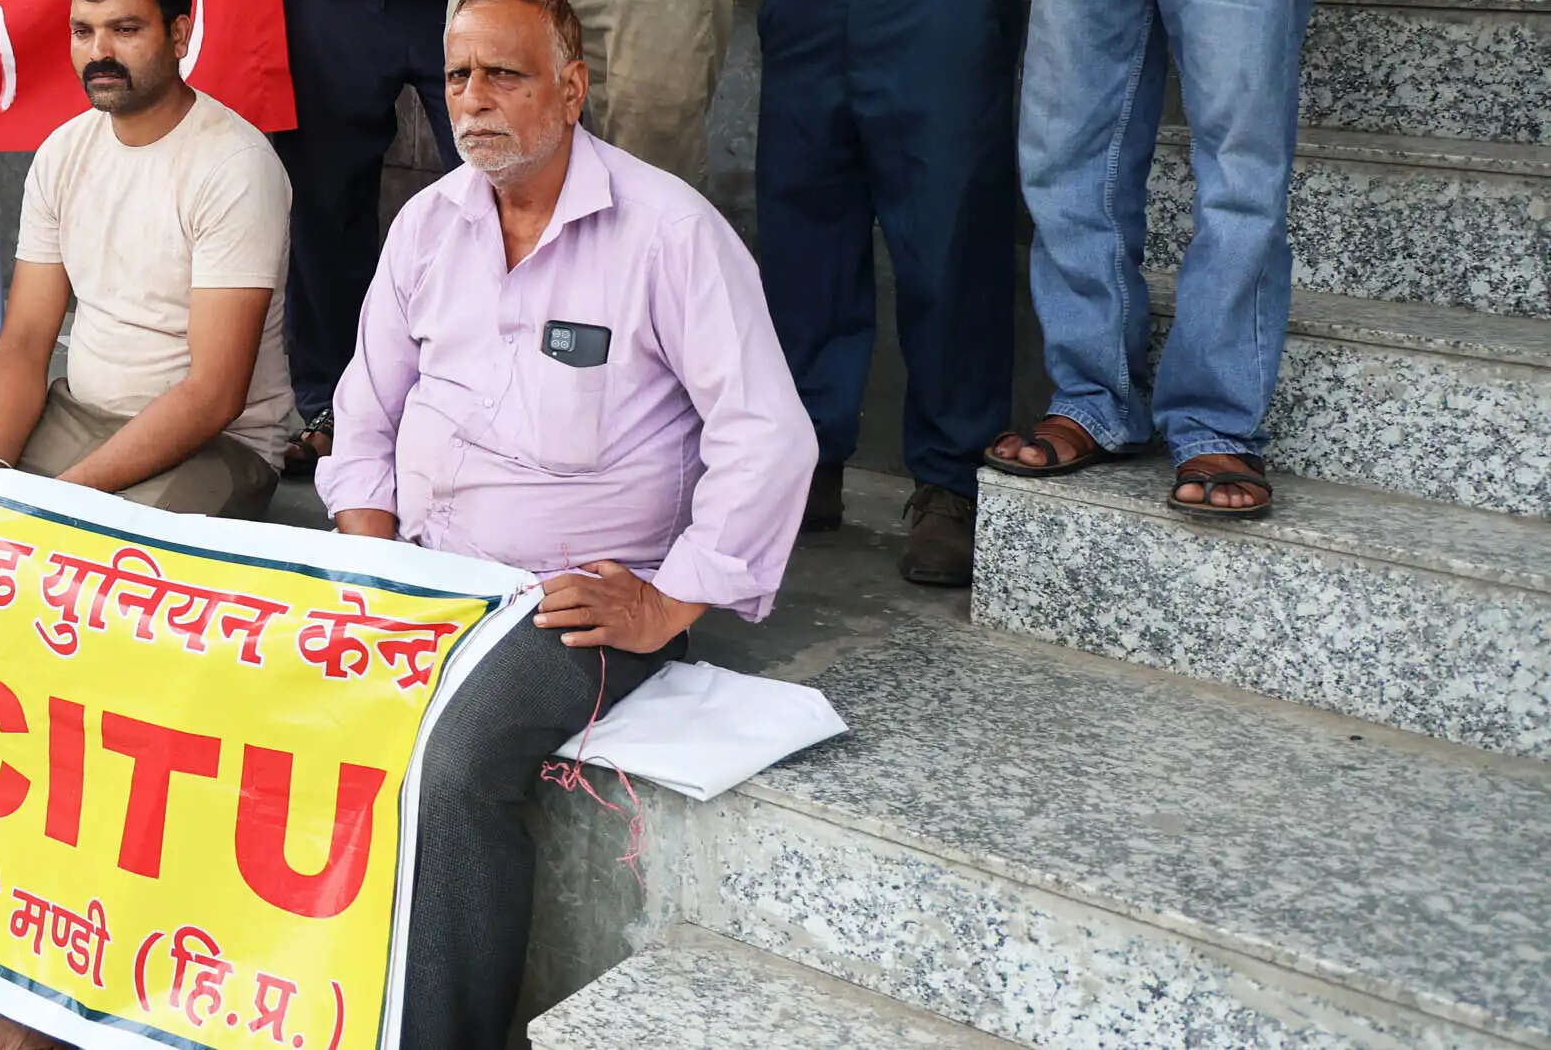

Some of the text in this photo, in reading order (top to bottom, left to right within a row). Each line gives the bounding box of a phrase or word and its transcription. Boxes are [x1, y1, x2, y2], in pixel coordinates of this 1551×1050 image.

[34, 546, 290, 667] युनियन
[298, 589, 460, 690] केन्द्र
[10, 888, 112, 988] मण्डी
